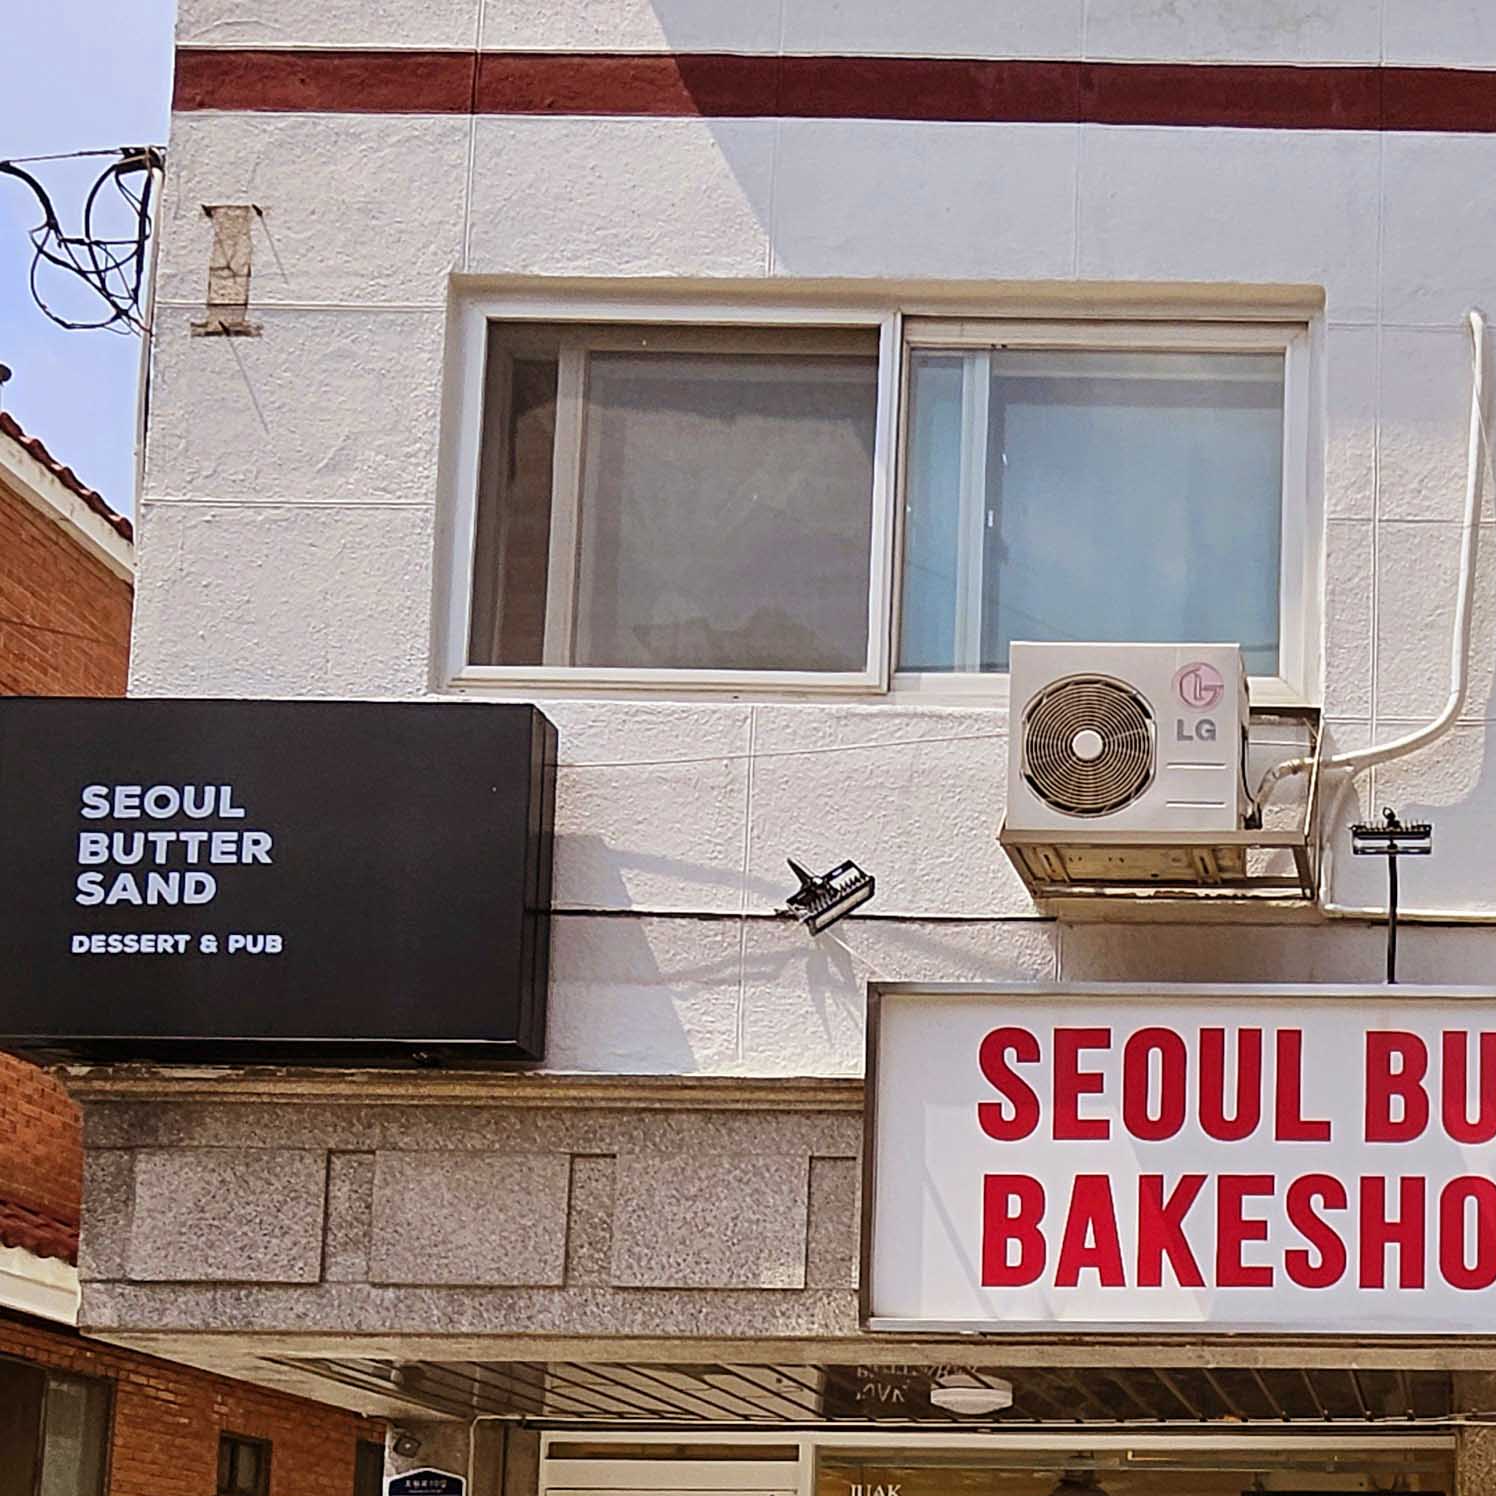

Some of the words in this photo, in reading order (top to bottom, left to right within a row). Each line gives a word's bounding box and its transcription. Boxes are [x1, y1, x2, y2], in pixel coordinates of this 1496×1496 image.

[1177, 718, 1217, 742] LG
[80, 785, 245, 820] SEOUL
[77, 831, 273, 865] BUTTER
[75, 871, 217, 906] SAND
[71, 934, 190, 954] DESSERT
[199, 935, 218, 954] &
[228, 934, 283, 954] PUB
[977, 1026, 1332, 1142] SEOUL
